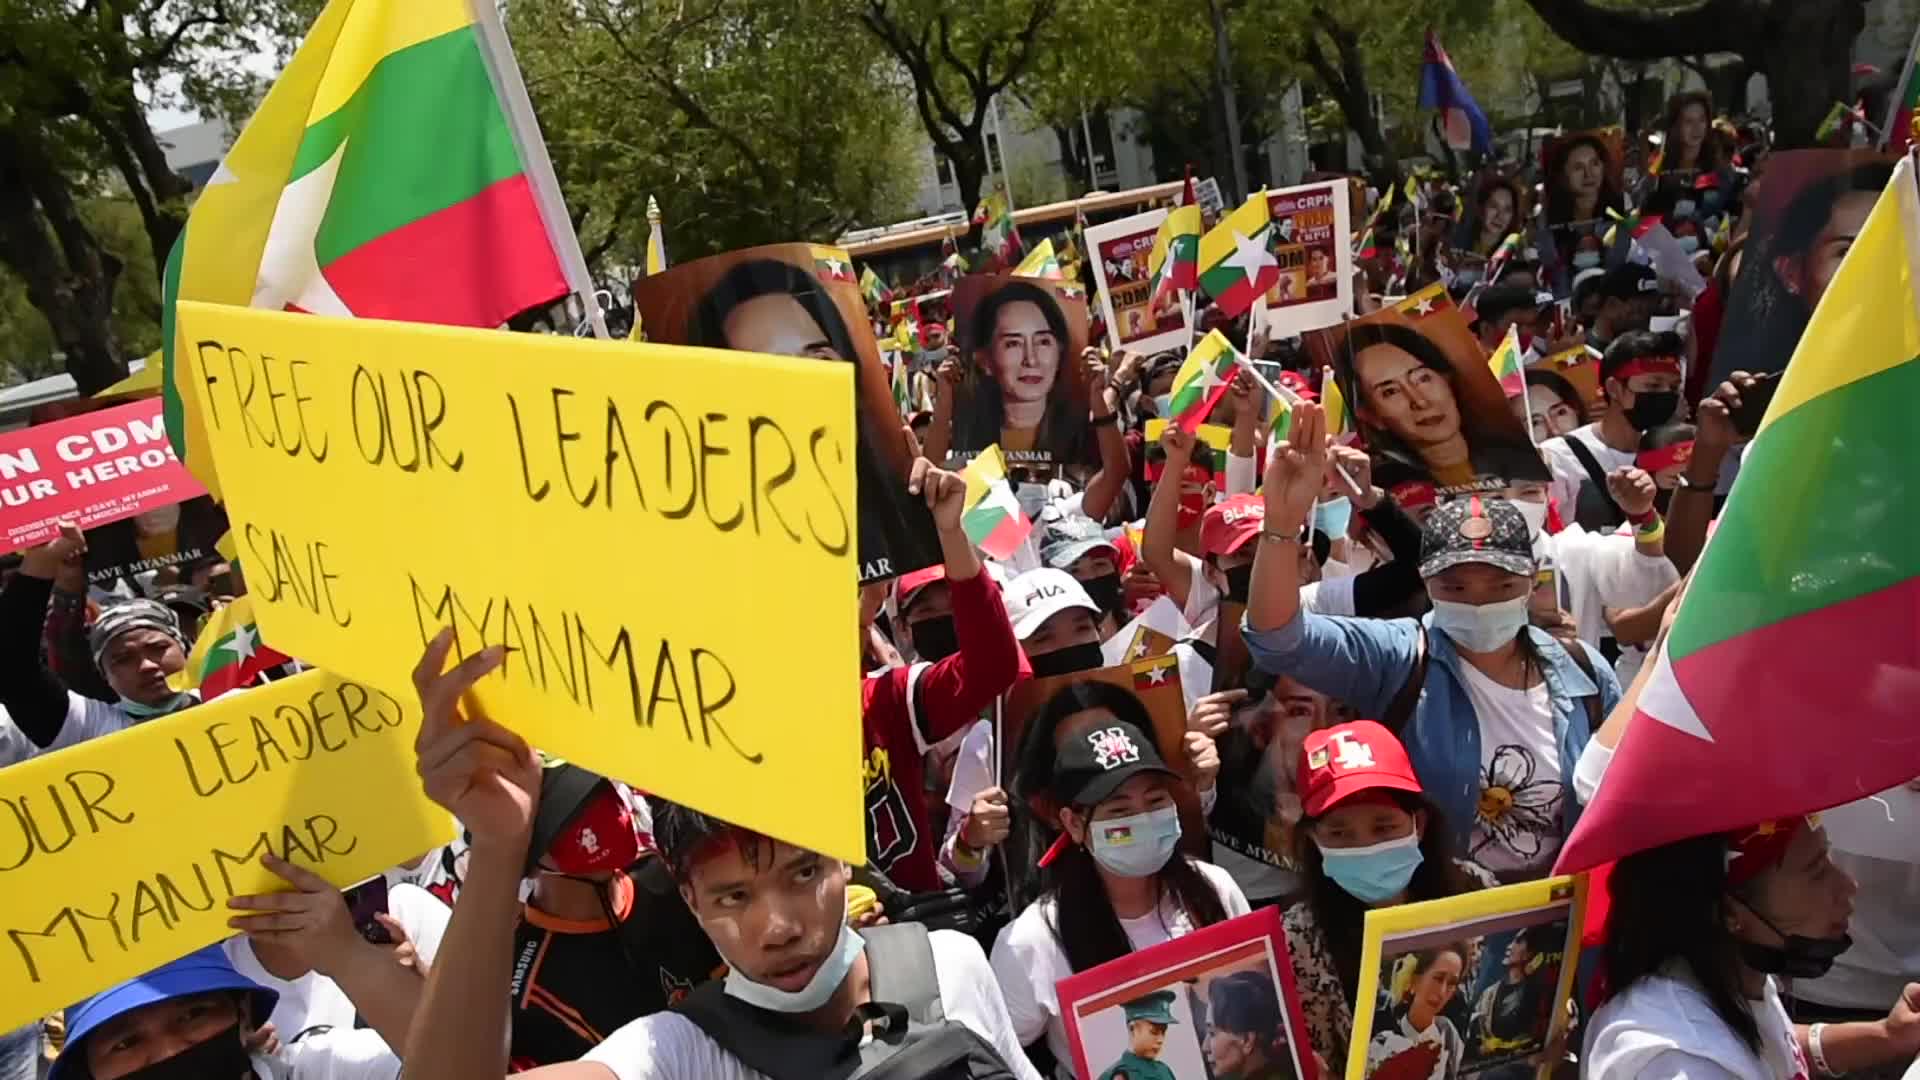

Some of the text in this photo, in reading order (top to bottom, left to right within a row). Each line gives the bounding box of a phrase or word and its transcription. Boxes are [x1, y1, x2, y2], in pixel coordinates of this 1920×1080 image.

[56, 414, 166, 462] CDM
[197, 341, 849, 557] FREE OUR LEADERS
[1005, 450, 1052, 461] ANMAR
[0, 479, 59, 509] UR
[129, 548, 202, 572] MYANMAR
[245, 523, 763, 763] SAVE MYANMAR
[175, 683, 402, 797] LEADERS
[8, 815, 357, 982] MYANMAR
